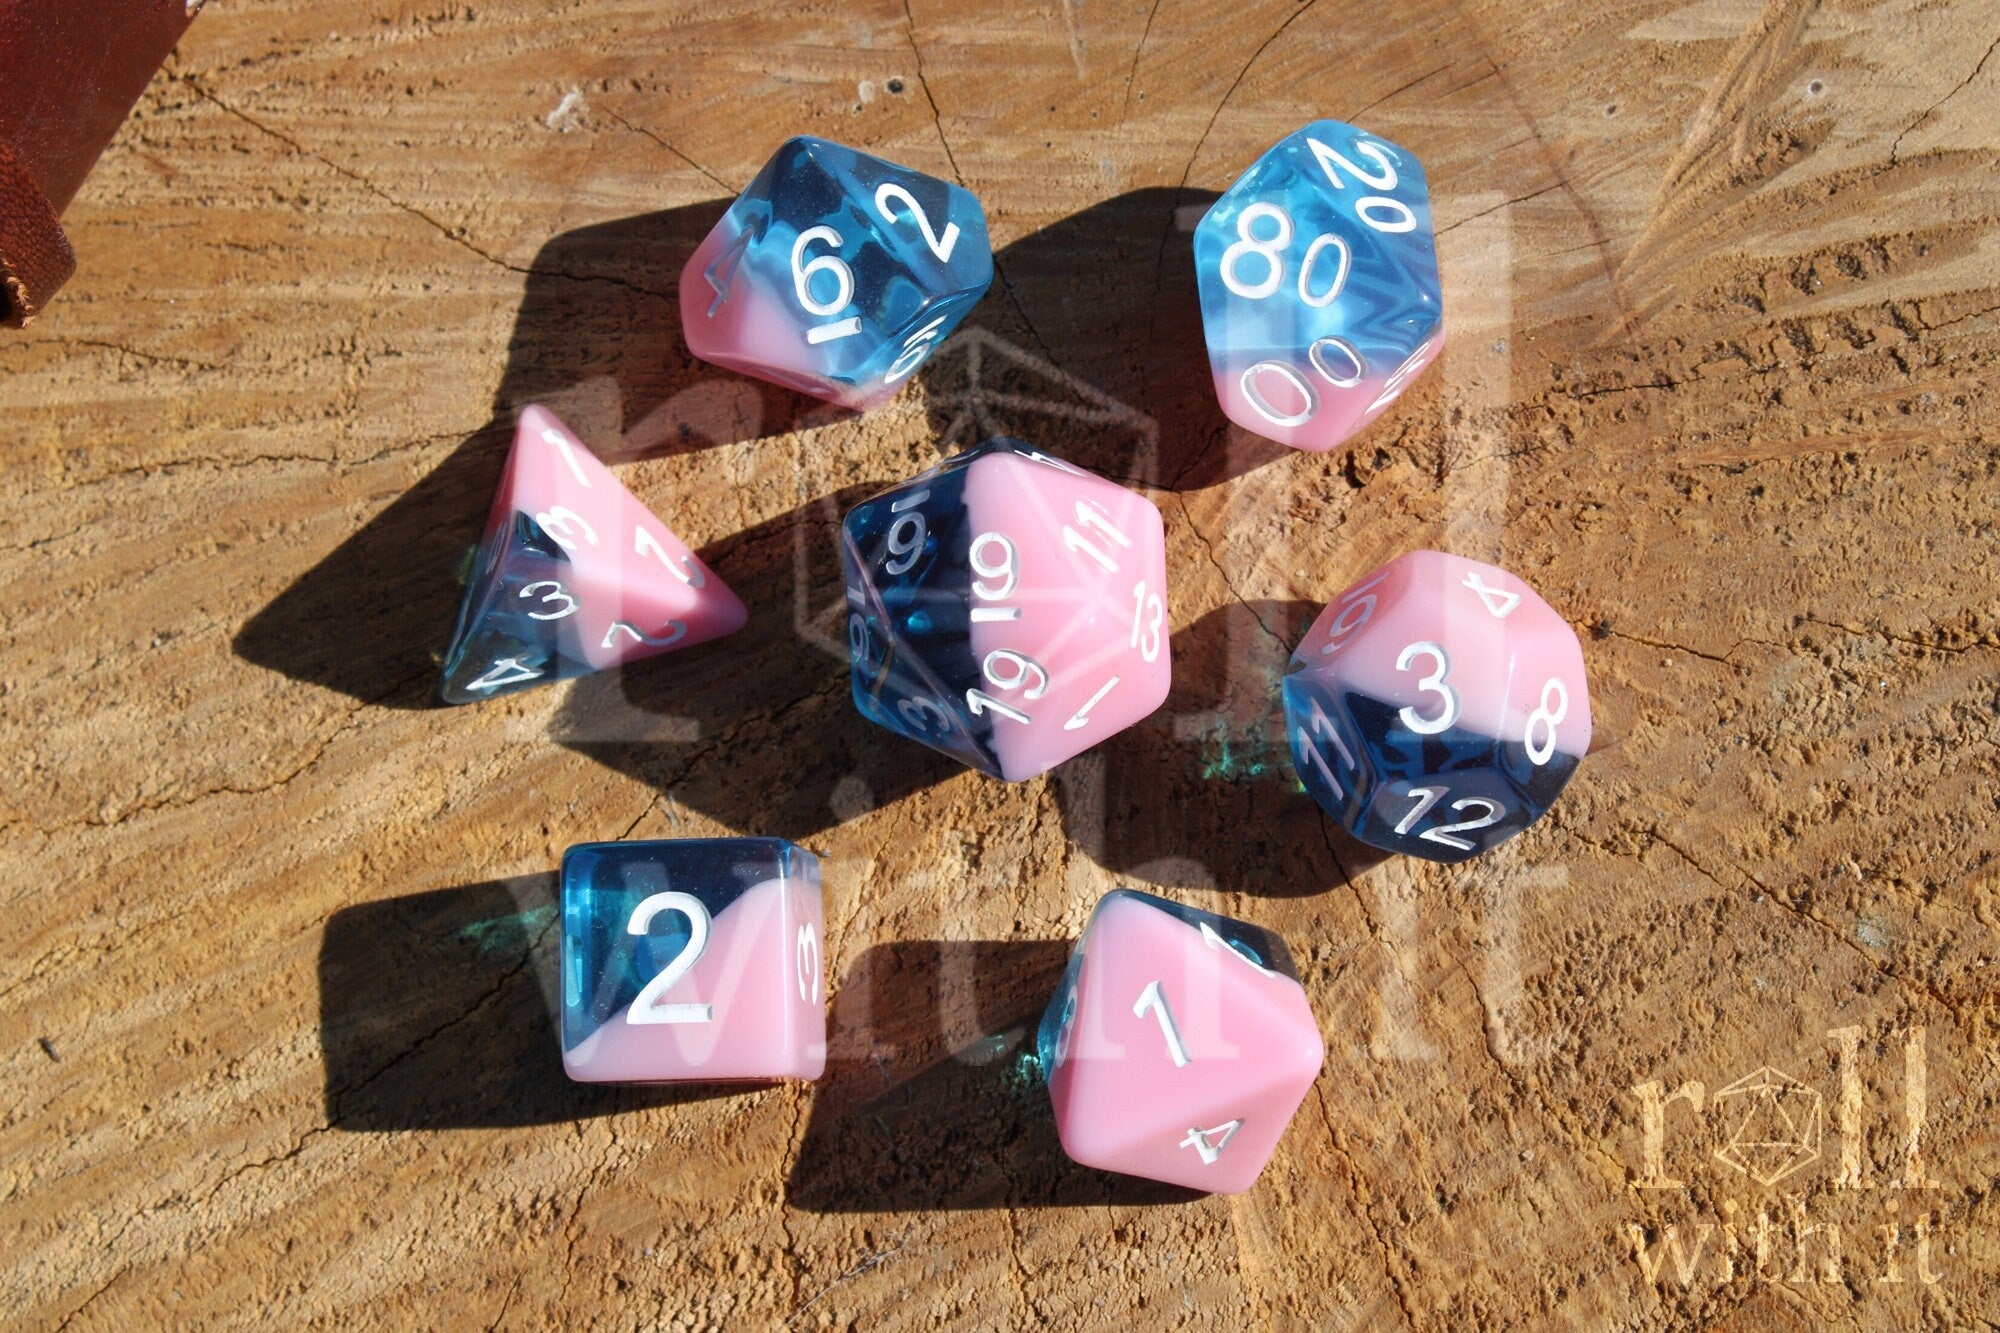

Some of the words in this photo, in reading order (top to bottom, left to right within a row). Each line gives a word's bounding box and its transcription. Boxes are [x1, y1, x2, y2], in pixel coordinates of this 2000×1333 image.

[874, 182, 961, 264] 2
[1306, 137, 1418, 233] 20
[1219, 201, 1351, 309] 80
[540, 428, 593, 488] 1
[535, 504, 600, 551] 3
[1061, 499, 1133, 574] 11
[518, 580, 581, 621] 3
[1130, 578, 1164, 664] 13
[1461, 570, 1522, 619] 4
[965, 647, 1050, 725] 19
[1395, 639, 1460, 735] 3
[1523, 676, 1569, 767] 8
[1297, 695, 1356, 802] 11
[1393, 786, 1506, 851] 12
[625, 890, 714, 1025] 2
[796, 921, 819, 1006] 3
[1131, 979, 1193, 1069] 1
[1177, 1116, 1246, 1166] 4
